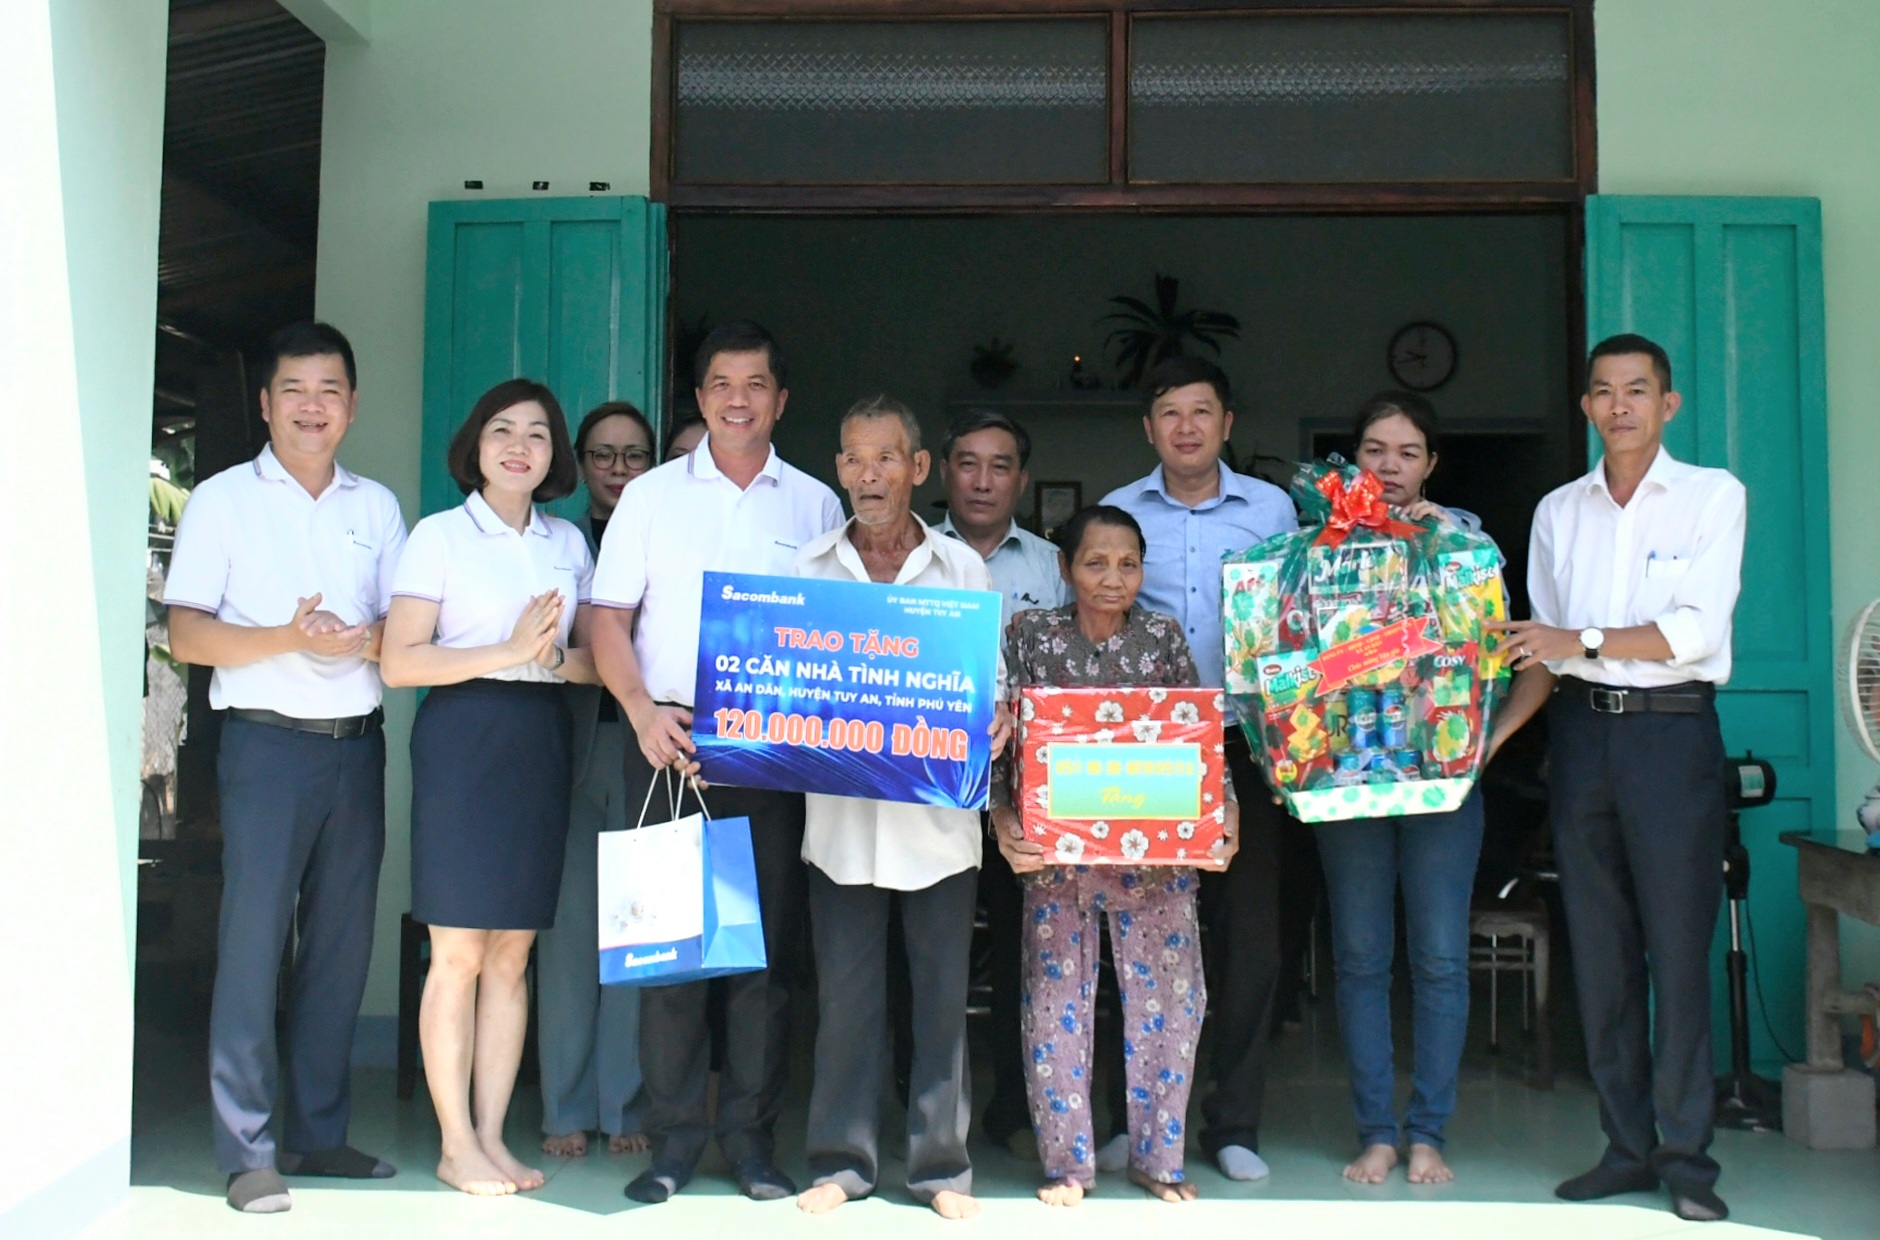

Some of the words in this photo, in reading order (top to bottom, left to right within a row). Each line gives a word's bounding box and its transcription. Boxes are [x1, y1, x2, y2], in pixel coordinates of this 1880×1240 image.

[721, 585, 805, 606] Sacombank
[933, 609, 947, 617] TUY
[774, 626, 844, 652] TRAO
[849, 629, 919, 660] TẶNG
[715, 654, 740, 673] 02
[745, 654, 791, 677] CĂN
[796, 660, 843, 682] NHÀ
[848, 662, 900, 687] TÌNH
[905, 670, 976, 693] NGHĨA
[1264, 665, 1317, 697] Malkist
[715, 678, 732, 692] XÃ
[734, 683, 753, 694] AN
[789, 686, 831, 701] HUYỆN
[833, 691, 858, 703] TUY
[860, 693, 882, 707] AN,
[884, 692, 915, 708] TỈNH
[917, 697, 944, 711] PHÚ
[946, 699, 973, 713] YÊN
[714, 708, 884, 754] 120.000.000
[891, 716, 969, 762] ĐỒNG
